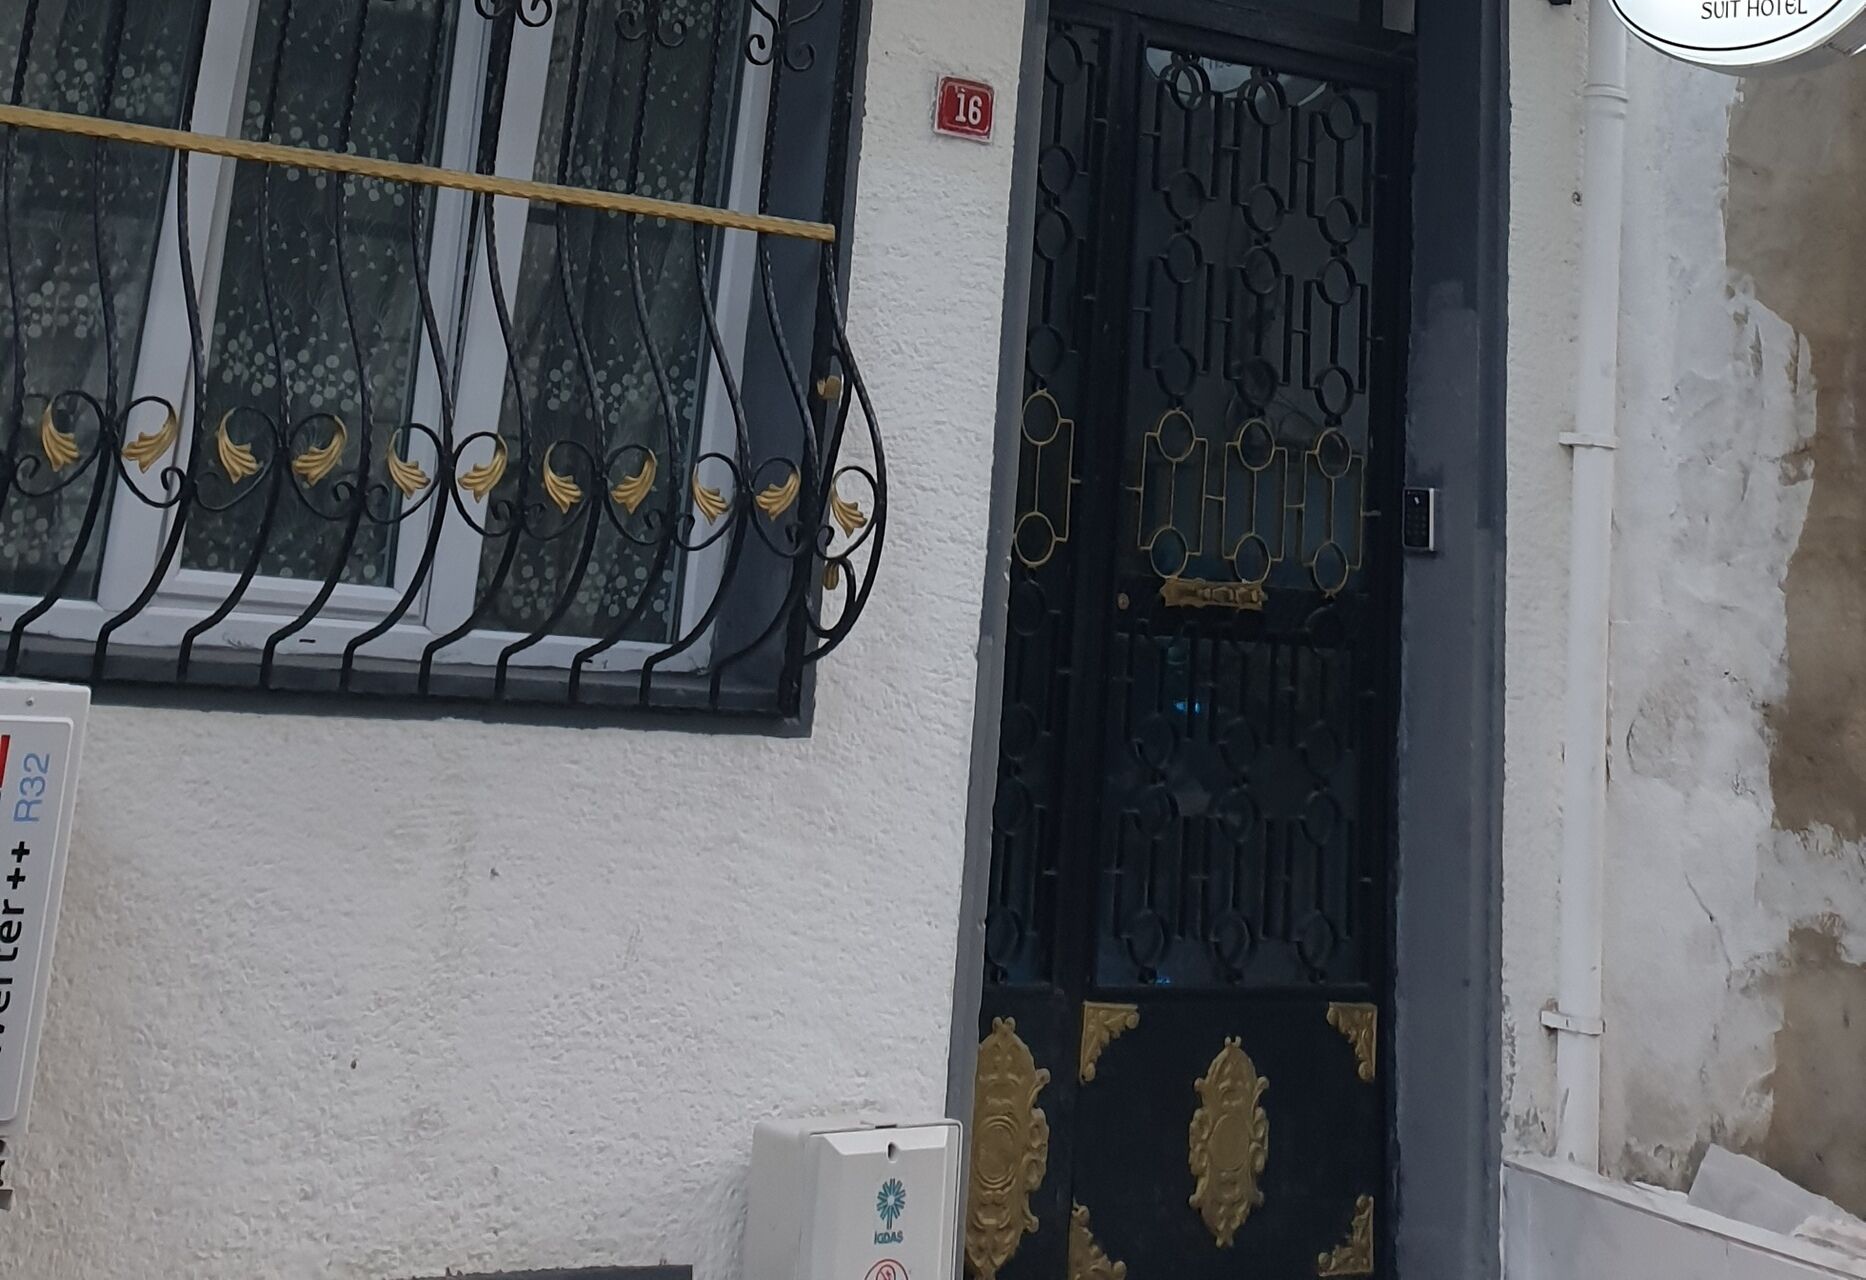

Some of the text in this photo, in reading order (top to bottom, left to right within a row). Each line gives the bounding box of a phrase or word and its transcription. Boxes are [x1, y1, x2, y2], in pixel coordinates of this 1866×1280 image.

[1701, 0, 1741, 20] SUIT
[955, 92, 982, 125] 16
[14, 753, 50, 822] R32
